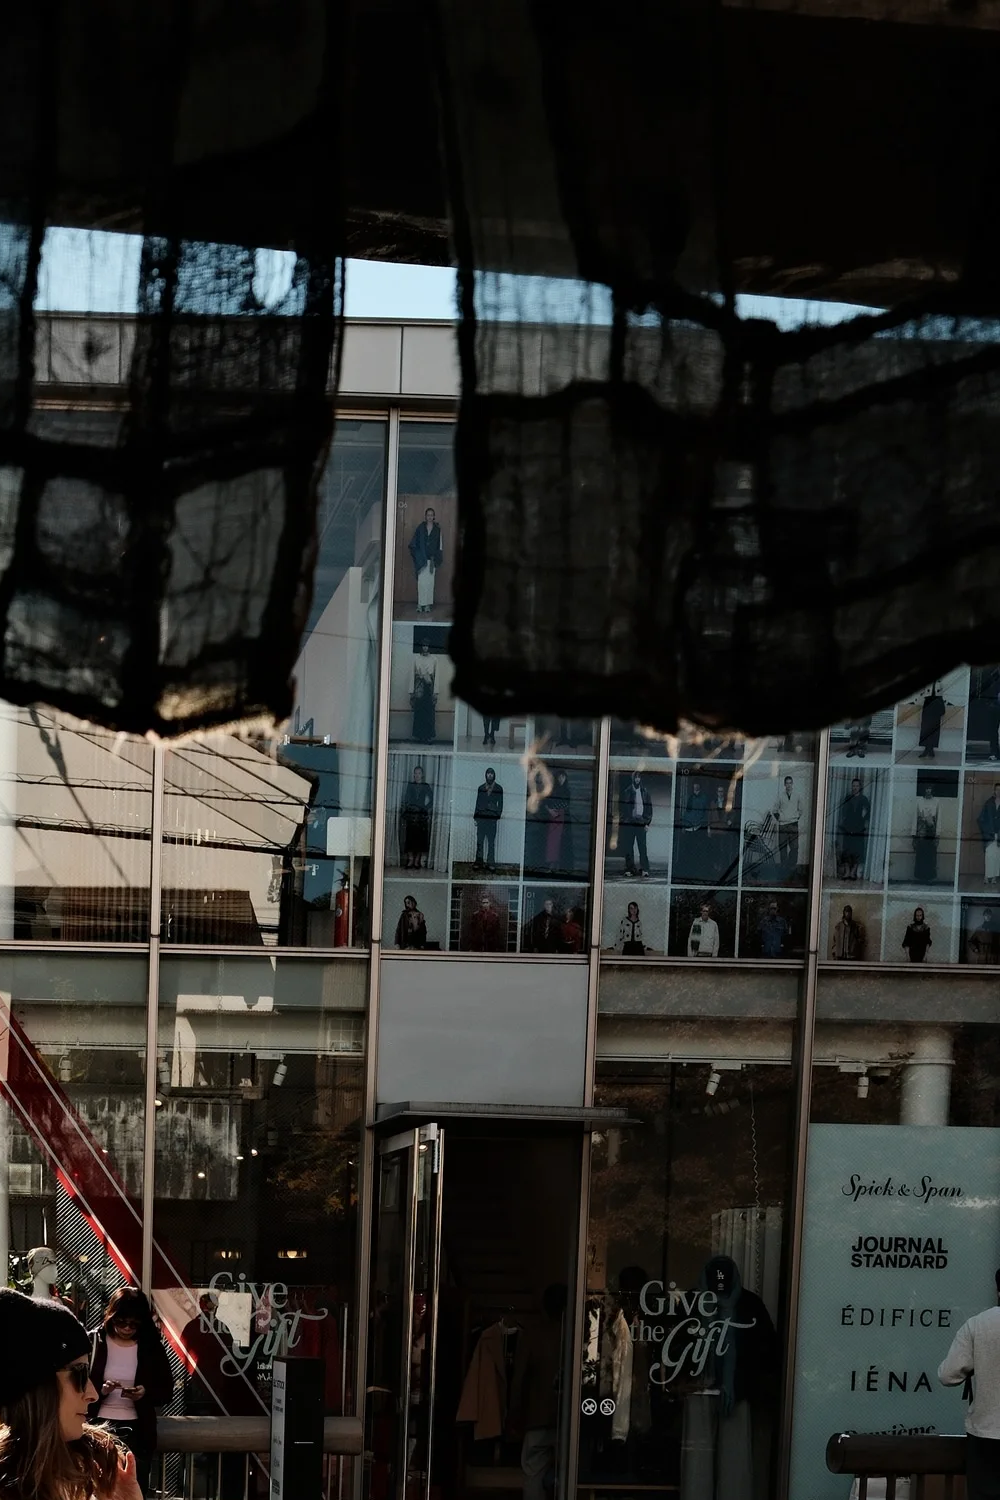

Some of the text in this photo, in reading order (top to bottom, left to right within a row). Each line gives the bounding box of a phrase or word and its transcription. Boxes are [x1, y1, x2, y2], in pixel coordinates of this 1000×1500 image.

[842, 1174, 964, 1203] Spick & Span
[851, 1236, 948, 1254] JOURNAL
[850, 1254, 948, 1269] STANDARD
[639, 1280, 718, 1317] Give
[841, 1304, 951, 1328] ÉDIFICE
[629, 1317, 757, 1385] the Gift
[850, 1365, 933, 1393] IÉNA
